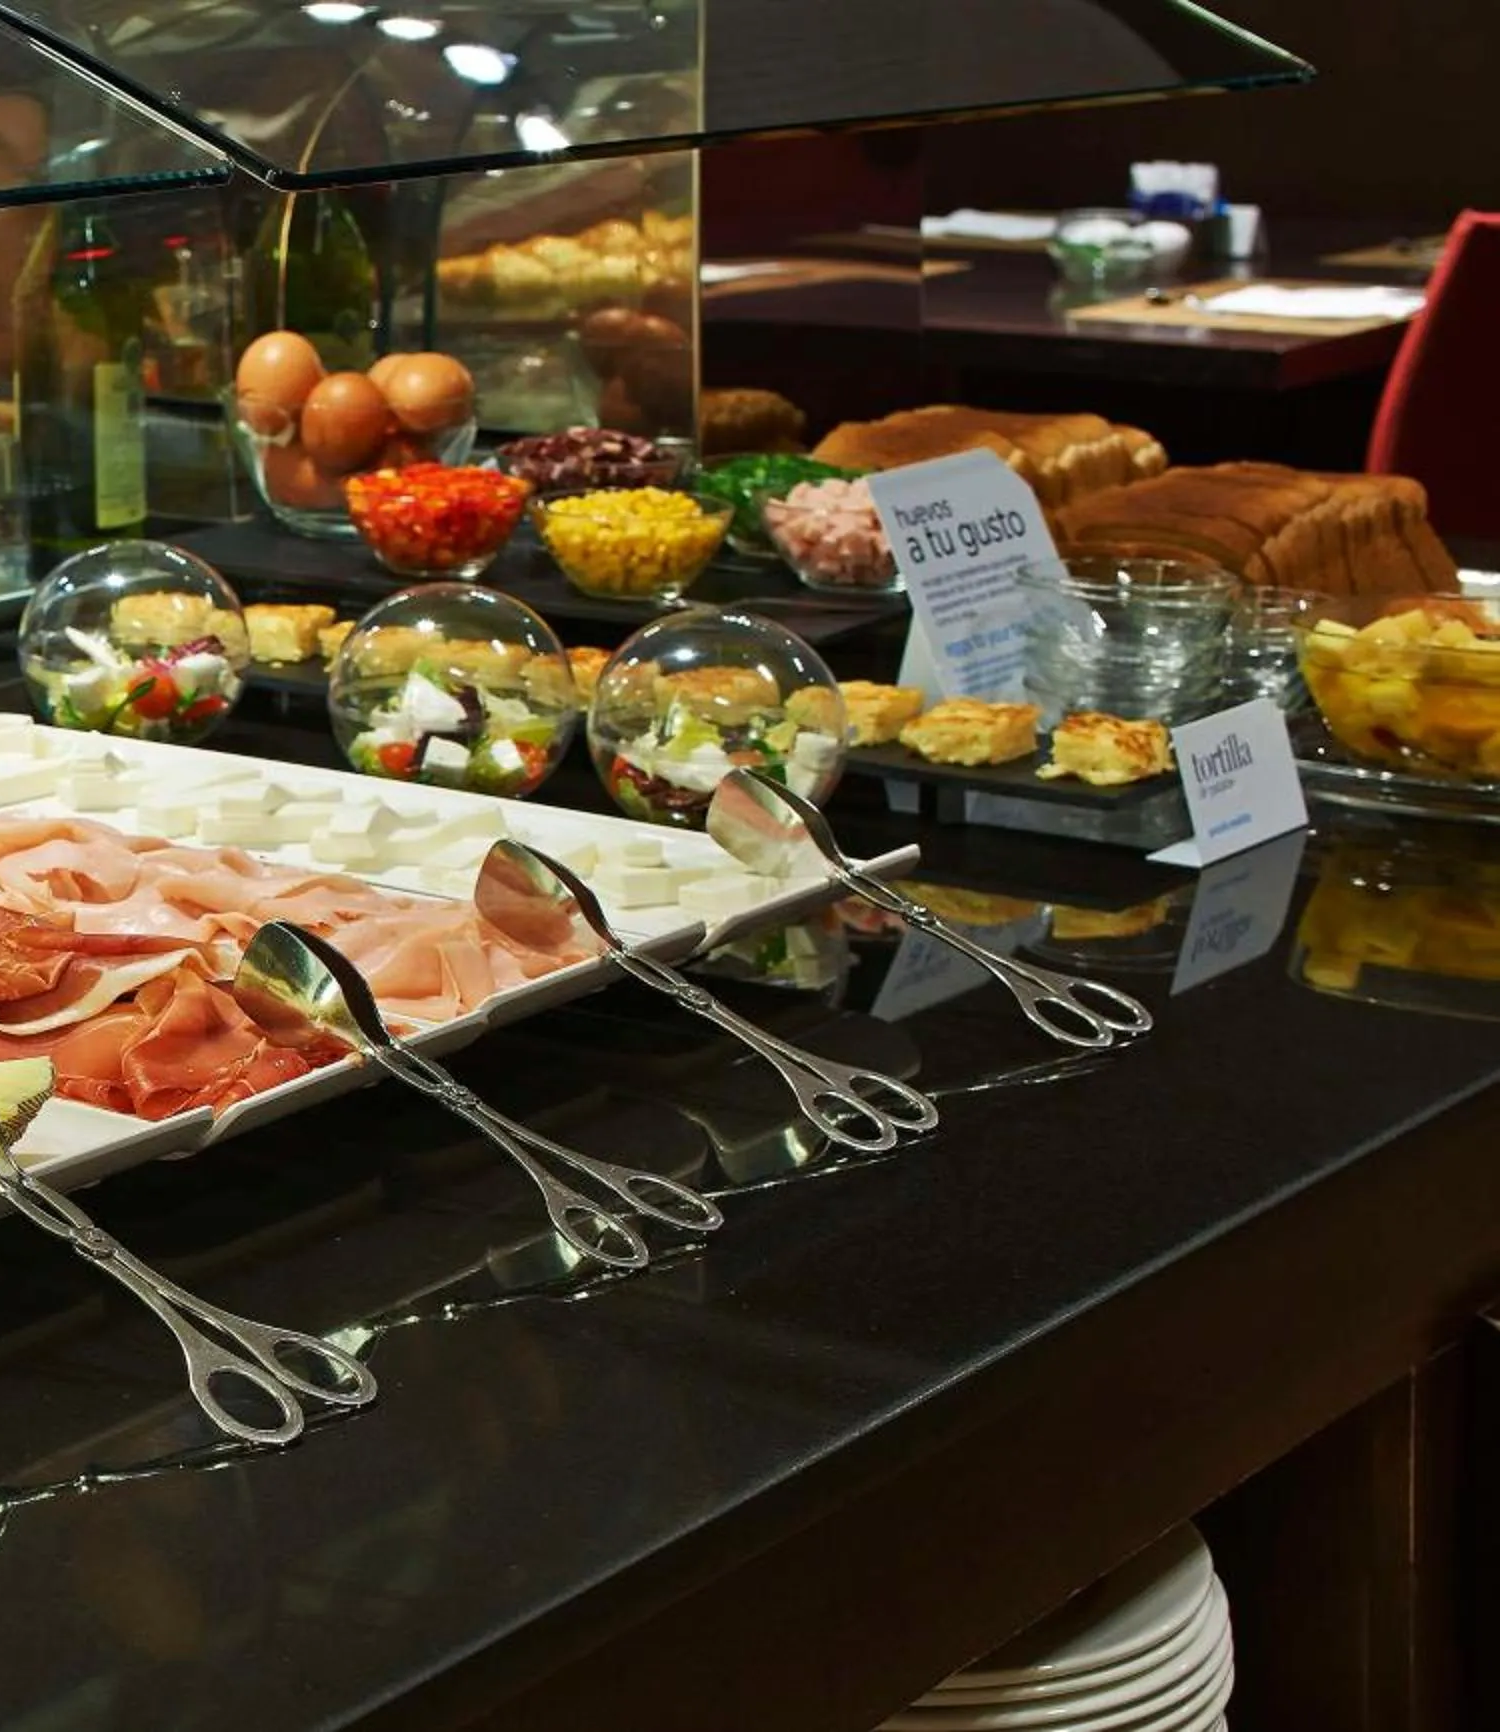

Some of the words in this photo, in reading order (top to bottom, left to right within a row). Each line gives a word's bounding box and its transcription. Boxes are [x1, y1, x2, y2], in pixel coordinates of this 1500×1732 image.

[893, 500, 953, 529] huevos
[906, 535, 926, 564] a
[924, 525, 956, 558] tu
[958, 506, 1026, 557] gusto
[1191, 732, 1253, 784] tortilla
